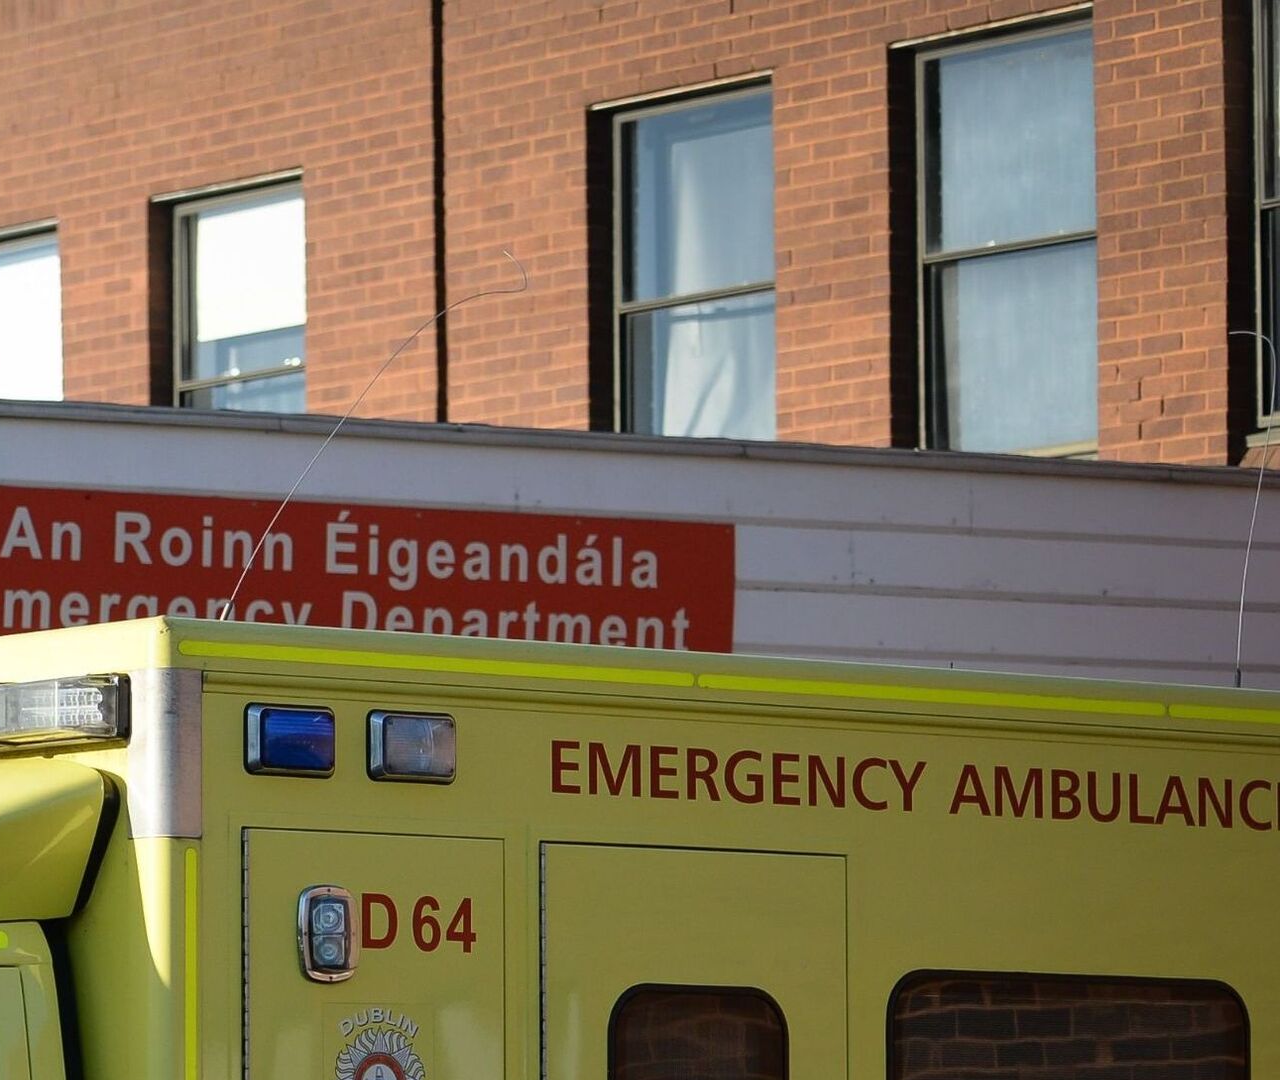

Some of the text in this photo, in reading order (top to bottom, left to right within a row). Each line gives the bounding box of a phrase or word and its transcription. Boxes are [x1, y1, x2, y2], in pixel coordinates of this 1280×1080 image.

[0, 506, 658, 591] An Roinn Éigeandála
[551, 739, 1280, 832] EMERGENCY AMBULANC
[361, 892, 477, 954] D 64
[337, 1007, 420, 1040] DUBLIN
